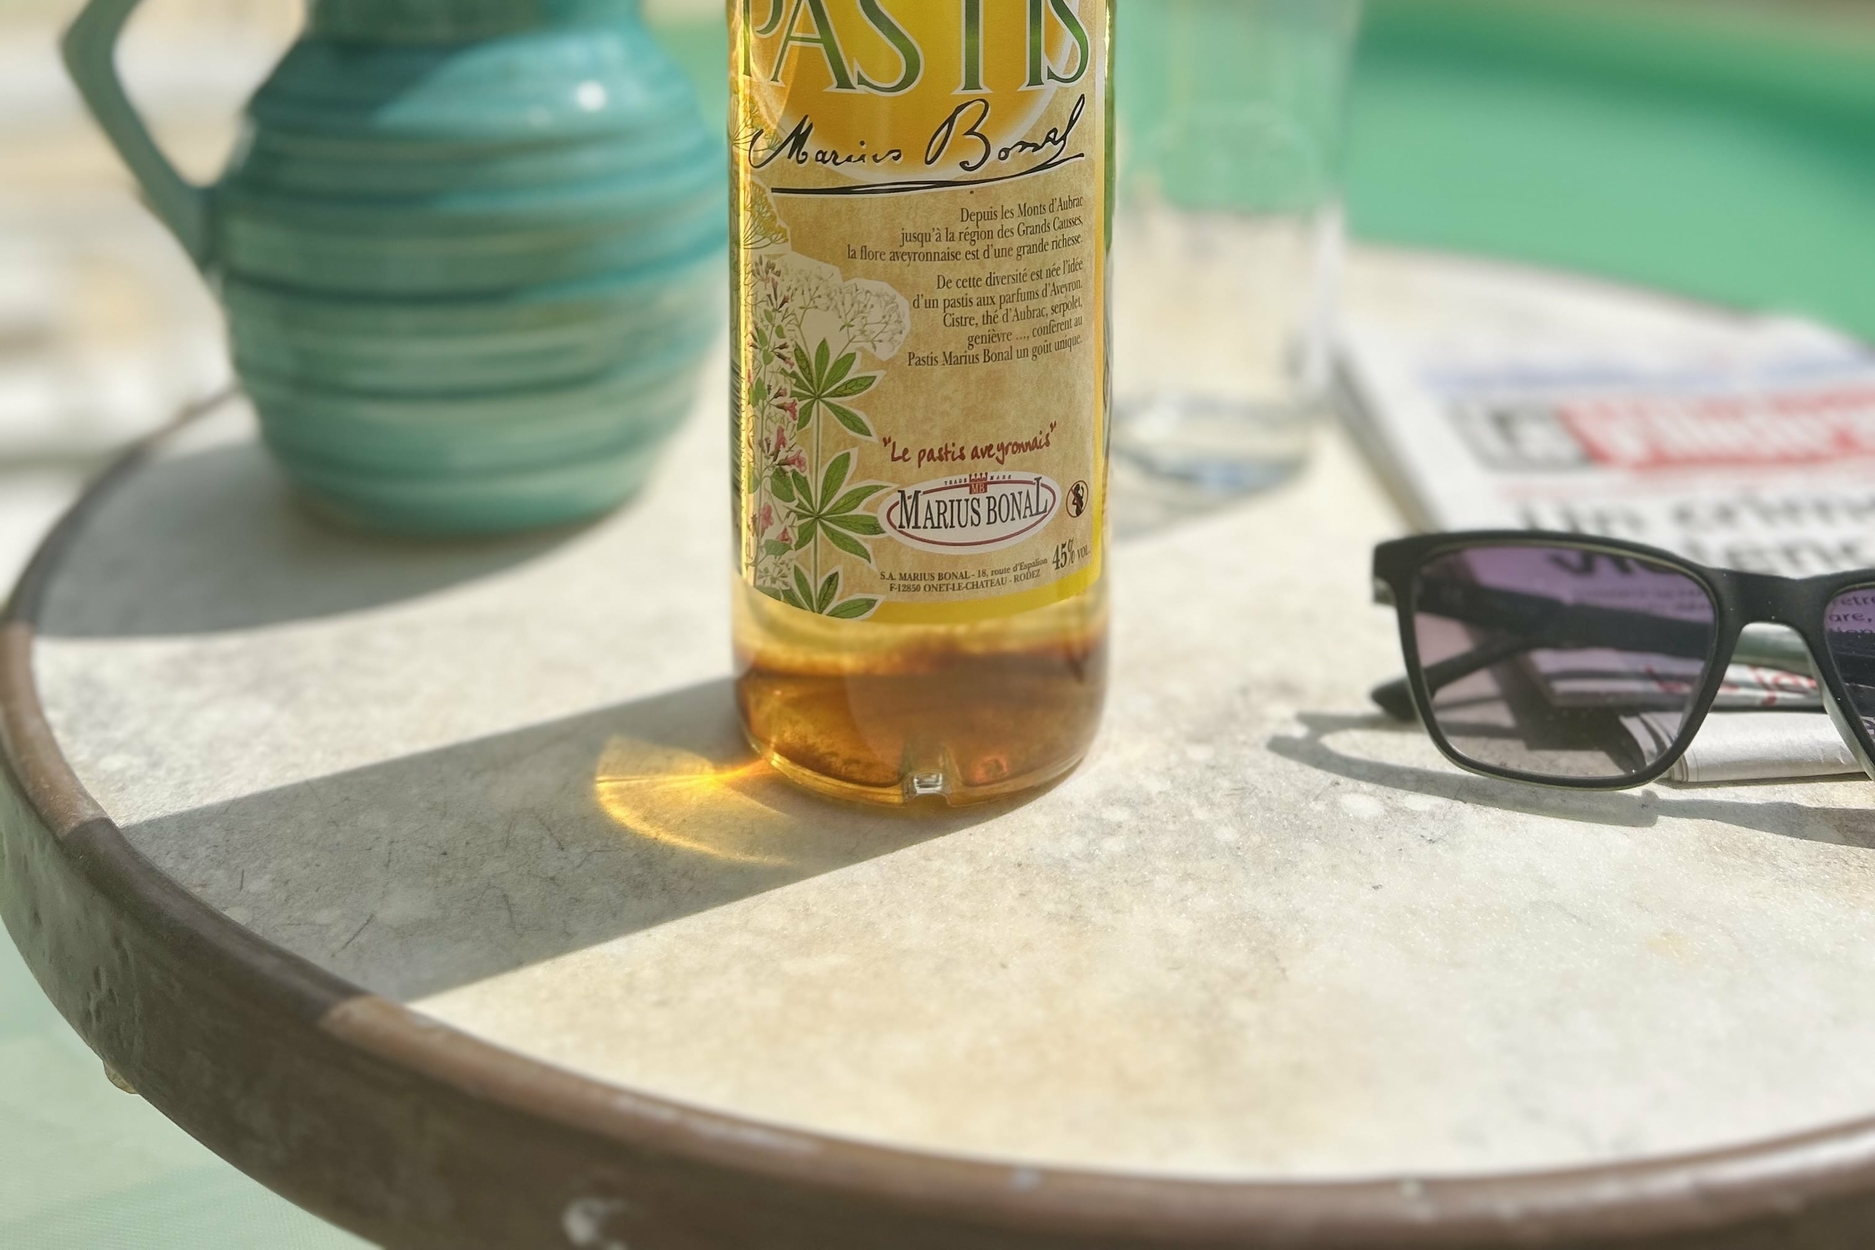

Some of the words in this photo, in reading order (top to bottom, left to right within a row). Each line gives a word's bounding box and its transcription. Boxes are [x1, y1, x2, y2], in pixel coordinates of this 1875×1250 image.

[748, 114, 902, 169] Marius
[924, 94, 1085, 171] Bonal
[961, 206, 998, 228] Depuis
[1001, 205, 1014, 219] les
[1017, 202, 1047, 218] Monts
[1049, 195, 1083, 213] d'Aubrac
[899, 227, 942, 247] jusqu'à
[945, 227, 955, 242] la
[959, 227, 993, 246] région
[997, 224, 1014, 238] des
[1017, 219, 1050, 236] Grands
[847, 244, 857, 259] la
[860, 245, 886, 261] flore
[889, 247, 961, 266] aveyronnaise
[965, 247, 979, 260] est
[983, 244, 1013, 258] d'une
[1016, 238, 1049, 261] grande
[936, 274, 952, 289] De
[956, 274, 982, 289] cette
[985, 268, 1027, 286] diversité
[1030, 269, 1043, 281] est
[1046, 263, 1060, 278] née
[1062, 257, 1083, 275] l'idée
[913, 294, 939, 308] d'un
[943, 293, 973, 313] pastis
[977, 295, 996, 307] aux
[999, 288, 1039, 309] parfums
[943, 313, 979, 328] Cistre,
[982, 309, 999, 326] thé
[1002, 305, 1049, 323] d'Aubrac,
[967, 328, 1013, 350] genièvre
[1073, 315, 1083, 327] au
[908, 351, 939, 367] Pastis
[942, 350, 980, 366] Marius
[983, 346, 1013, 363] Bonal
[1016, 347, 1029, 359] un
[917, 442, 967, 468] pastis
[944, 477, 967, 485] TRADE
[971, 483, 985, 494] MB
[898, 490, 981, 530] MARIUS
[986, 476, 1049, 525] BONAL
[1052, 536, 1075, 570] 45%
[880, 571, 896, 581] S.A.
[899, 572, 935, 581] MARIUS
[938, 570, 970, 581] BONAL
[978, 569, 989, 578] 18,
[991, 567, 1011, 576] route
[1012, 557, 1048, 572] d'Espalion
[889, 583, 921, 593] F-12850
[923, 577, 1007, 592] ONET-LE-CHATEAU
[1013, 569, 1040, 583] RODEZ
